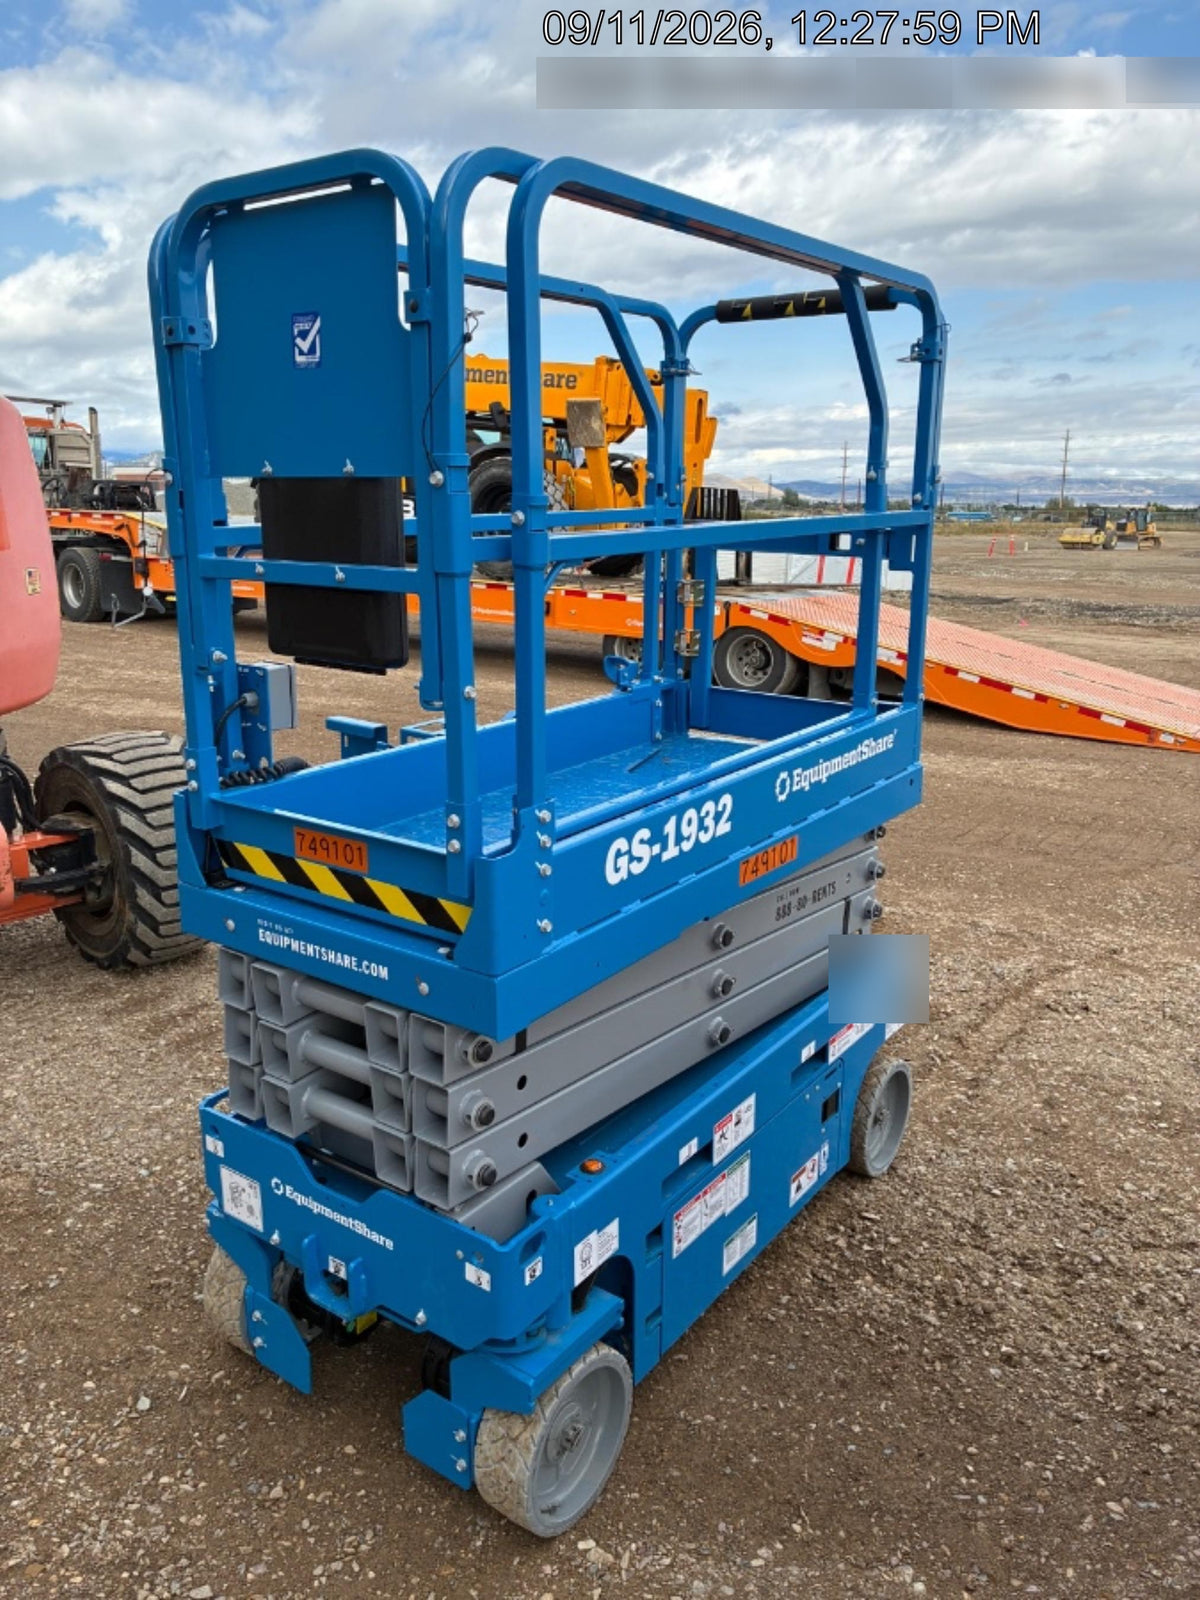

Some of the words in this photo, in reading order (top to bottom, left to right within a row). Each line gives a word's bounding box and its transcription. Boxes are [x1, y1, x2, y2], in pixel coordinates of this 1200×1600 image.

[792, 733, 894, 792] EquipmentShare
[296, 832, 365, 867] 749101
[605, 793, 734, 886] GS-1932
[741, 838, 797, 881] 749101
[258, 928, 389, 981] EQUIPMENTSHARE.COM
[285, 1184, 394, 1251] EquipmentShare
